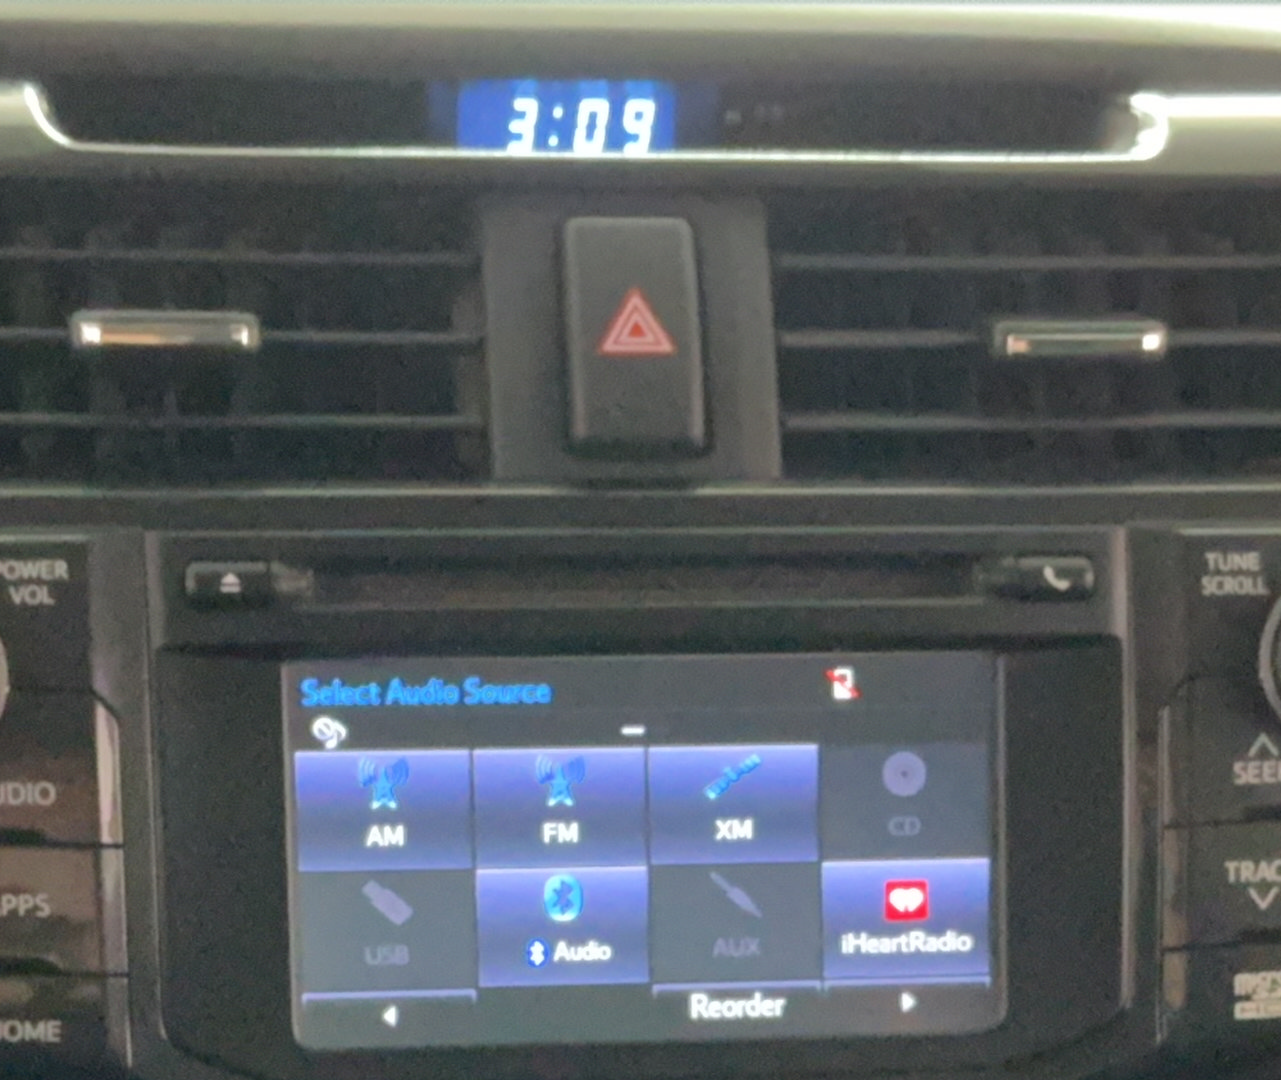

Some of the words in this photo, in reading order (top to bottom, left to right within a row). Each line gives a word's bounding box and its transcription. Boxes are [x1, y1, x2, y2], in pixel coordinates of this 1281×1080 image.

[507, 98, 656, 154] 3:09
[1205, 552, 1261, 572] TUNE
[10, 584, 55, 606] VOL
[1202, 576, 1269, 597] SCROLL
[300, 678, 381, 706] Select
[386, 677, 460, 706] Audio
[464, 676, 552, 704] Source
[366, 825, 405, 848] AM
[542, 822, 580, 844] FM
[714, 818, 754, 841] XM
[888, 816, 921, 837] CD
[553, 940, 612, 963] Audio
[712, 937, 761, 958] AUX
[841, 930, 974, 955] iHeartRadio
[363, 944, 410, 966] USB
[690, 992, 788, 1020] Reorder
